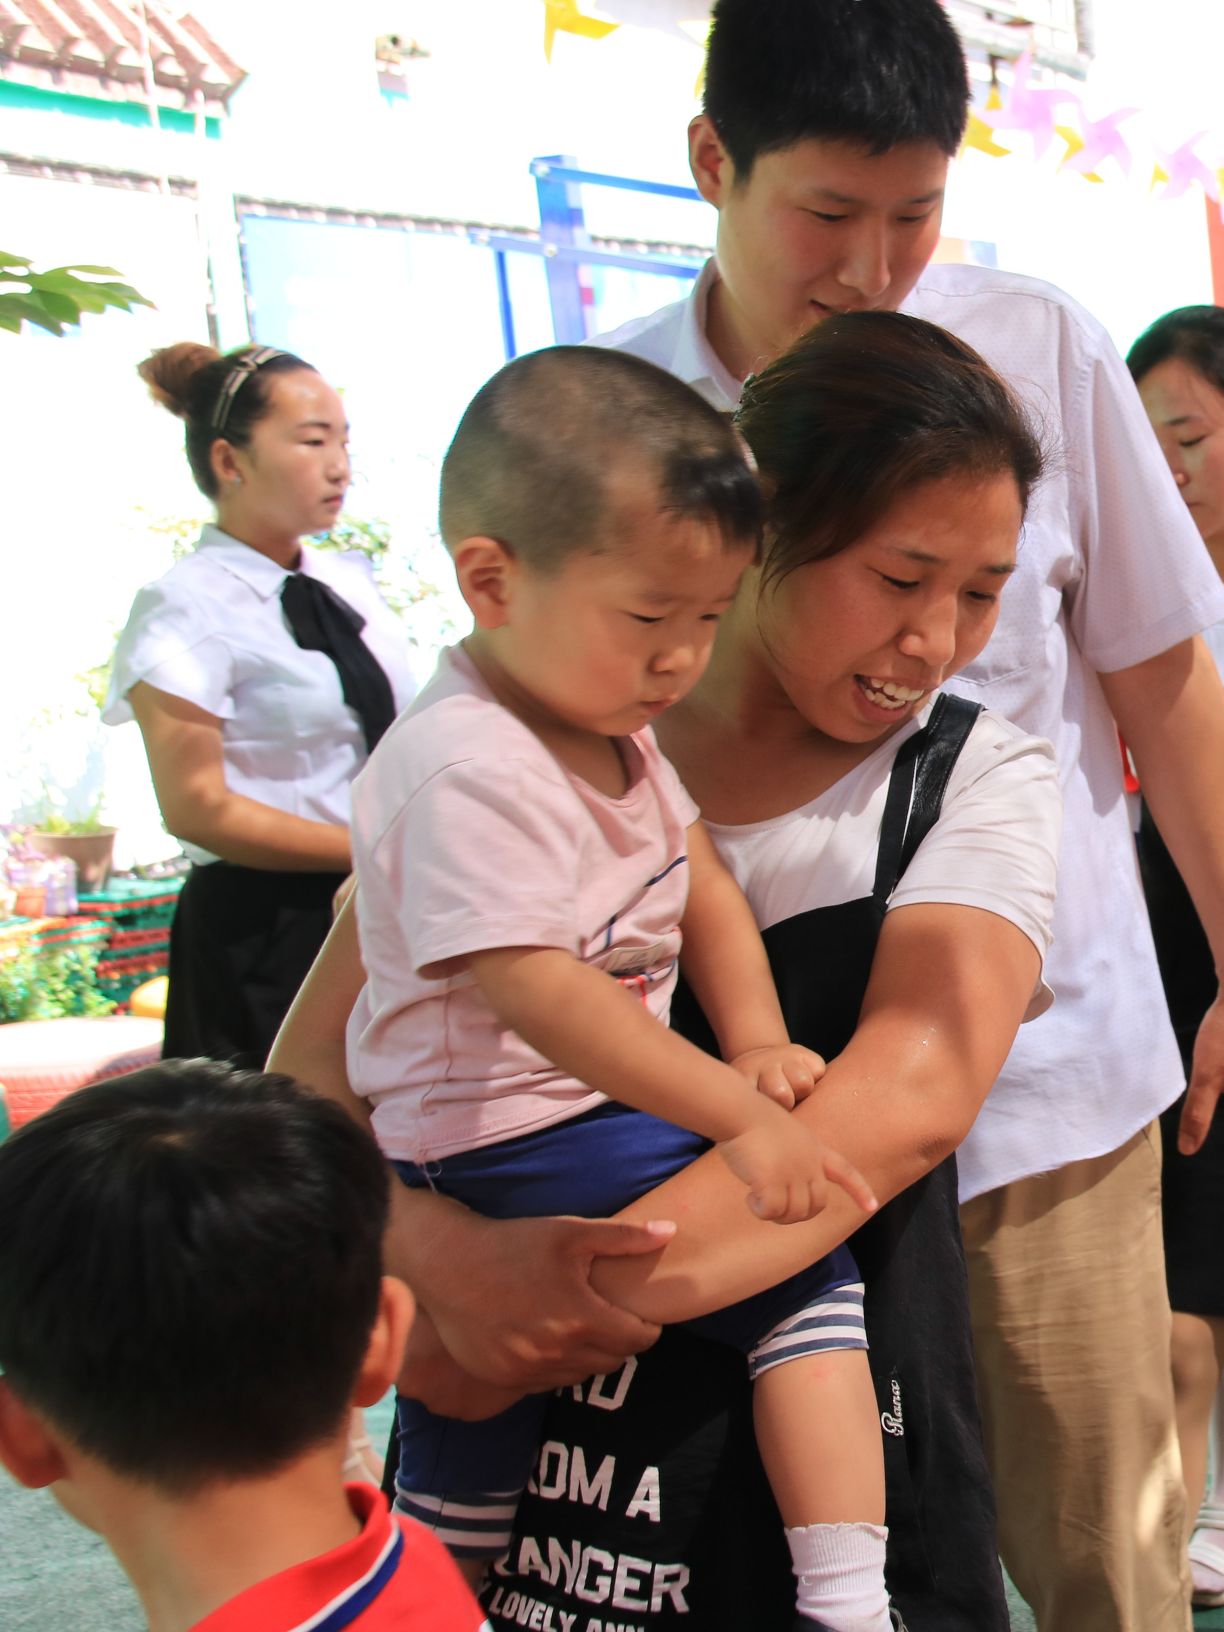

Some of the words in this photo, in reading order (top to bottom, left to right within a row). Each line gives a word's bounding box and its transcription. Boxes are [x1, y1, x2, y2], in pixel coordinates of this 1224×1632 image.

[527, 1439, 616, 1511] OM
[625, 1465, 661, 1522] A
[488, 1586, 578, 1632] LOVELY
